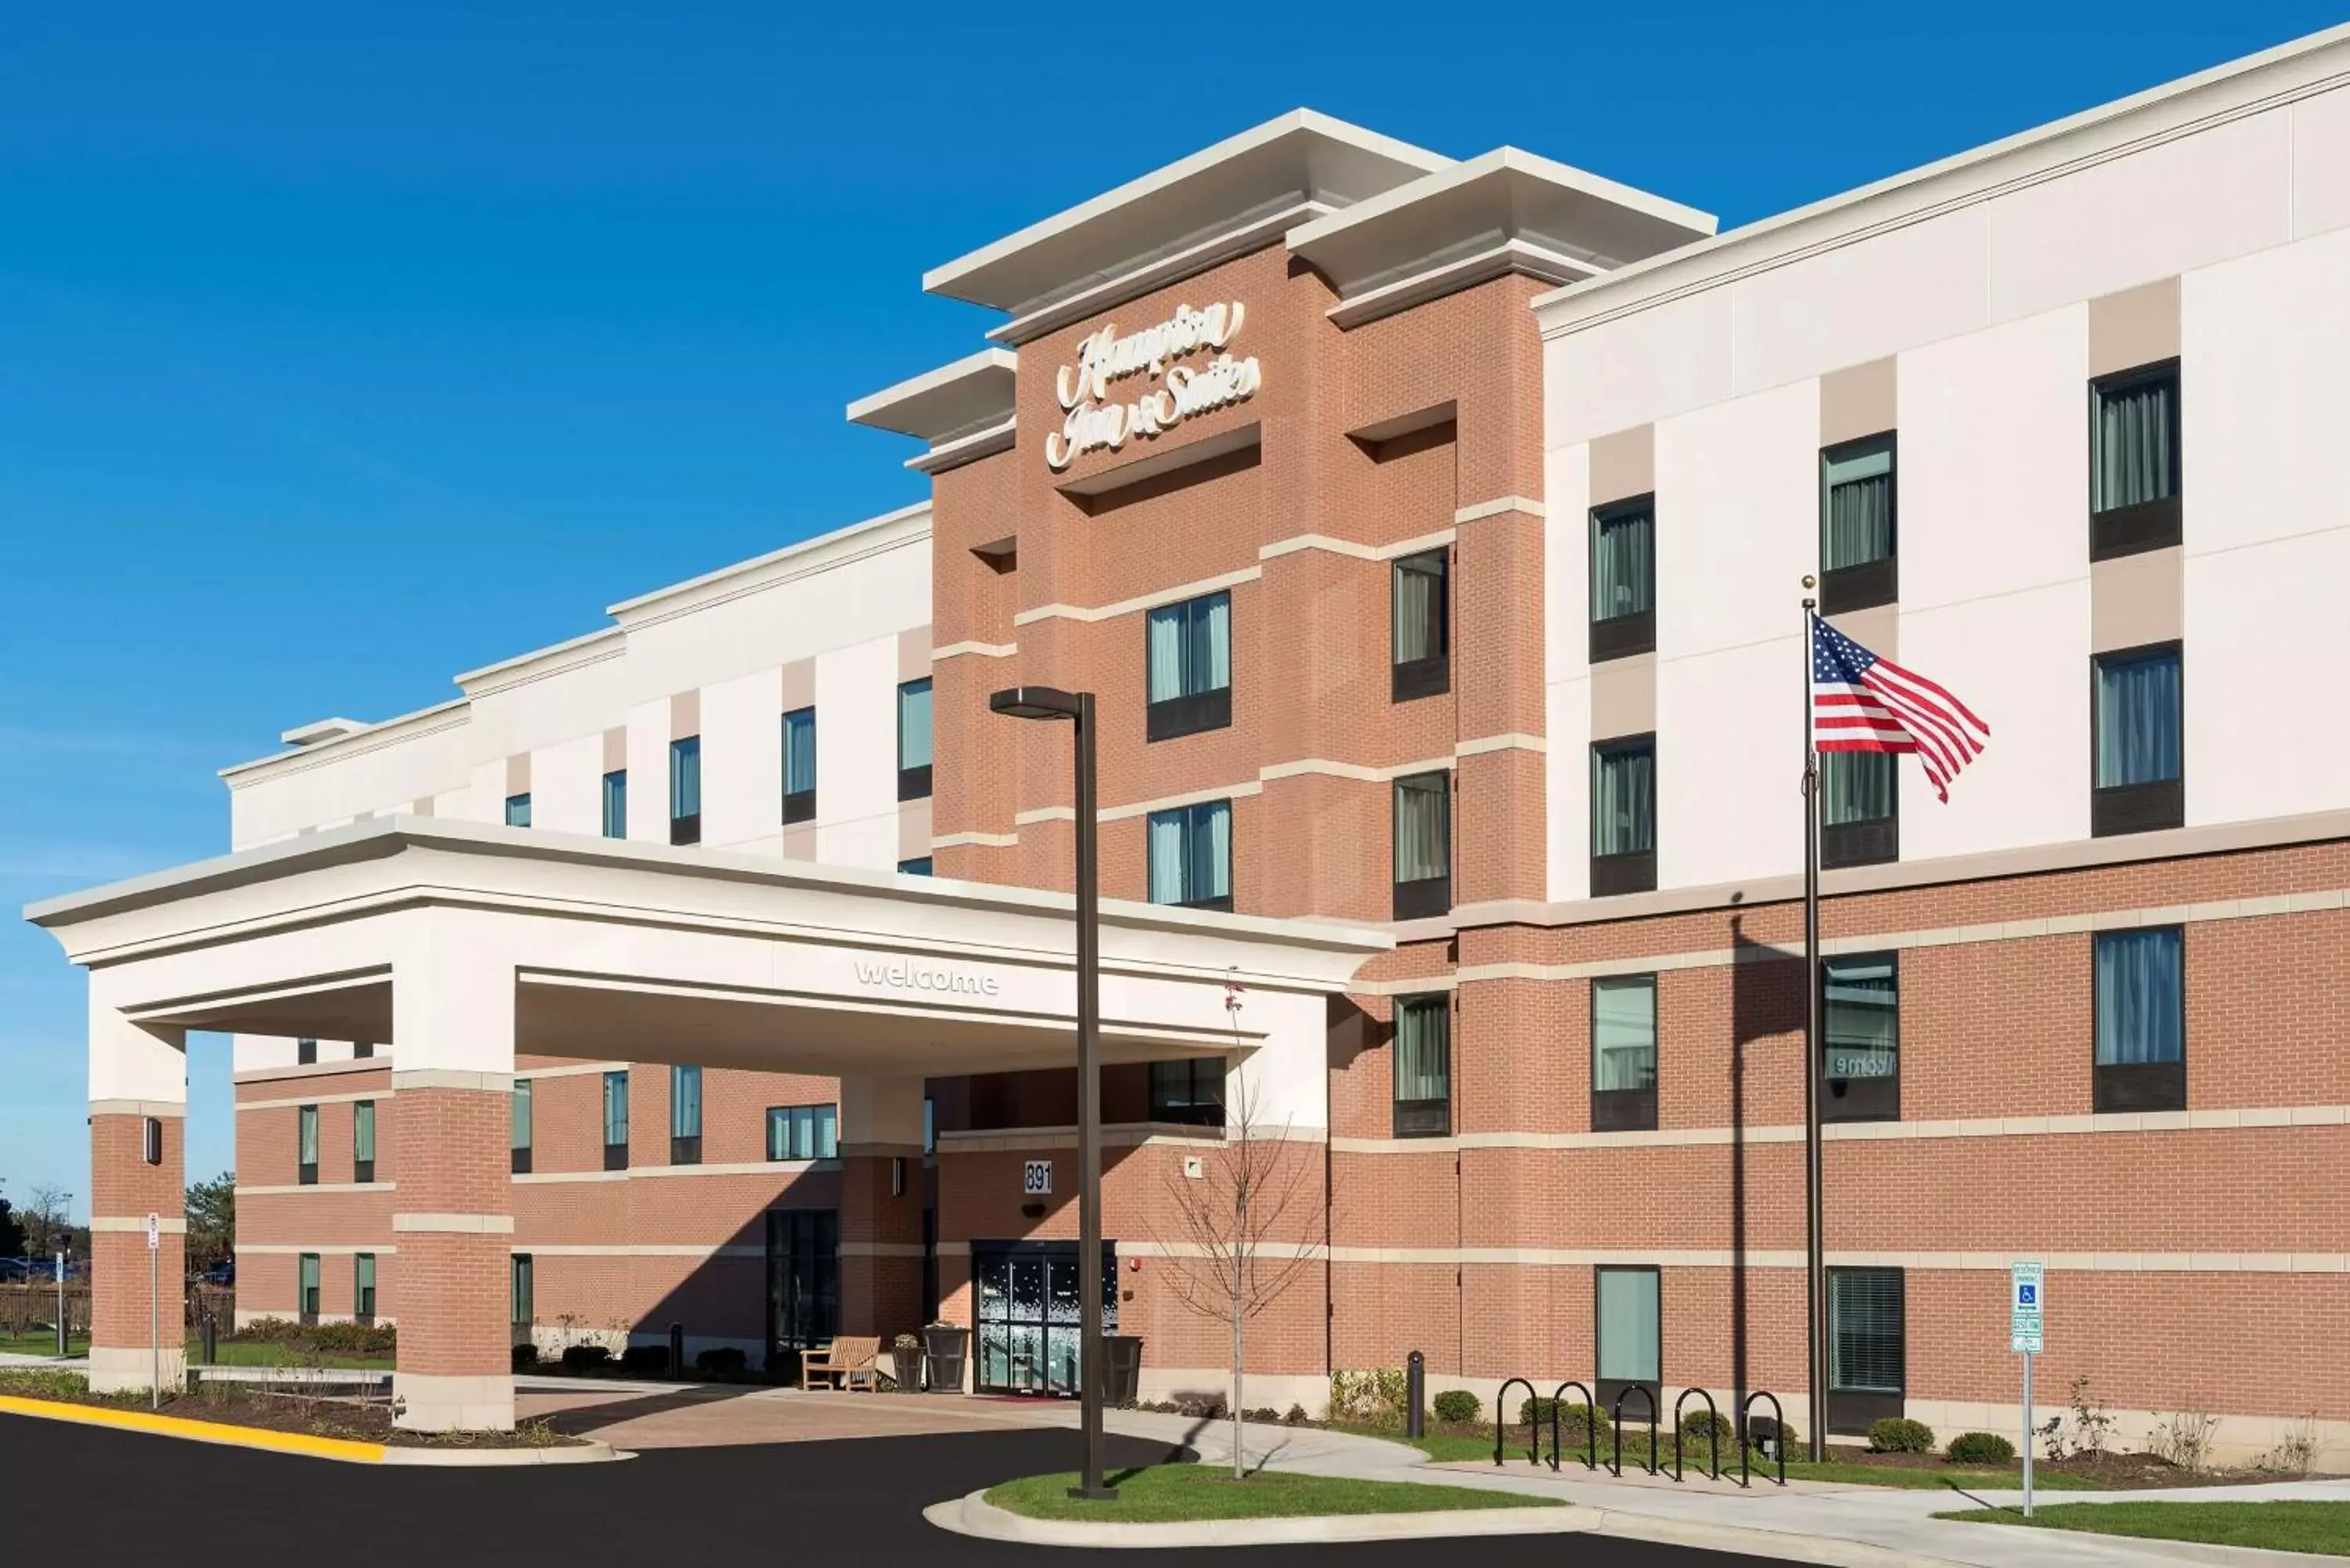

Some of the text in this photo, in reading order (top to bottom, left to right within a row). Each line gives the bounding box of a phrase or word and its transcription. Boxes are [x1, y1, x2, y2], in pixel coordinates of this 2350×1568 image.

[1057, 301, 1245, 407] Hampton
[1046, 400, 1137, 468] Inn
[1155, 354, 1261, 424] Suites
[855, 958, 1000, 995] welcome
[1027, 1163, 1050, 1190] 891
